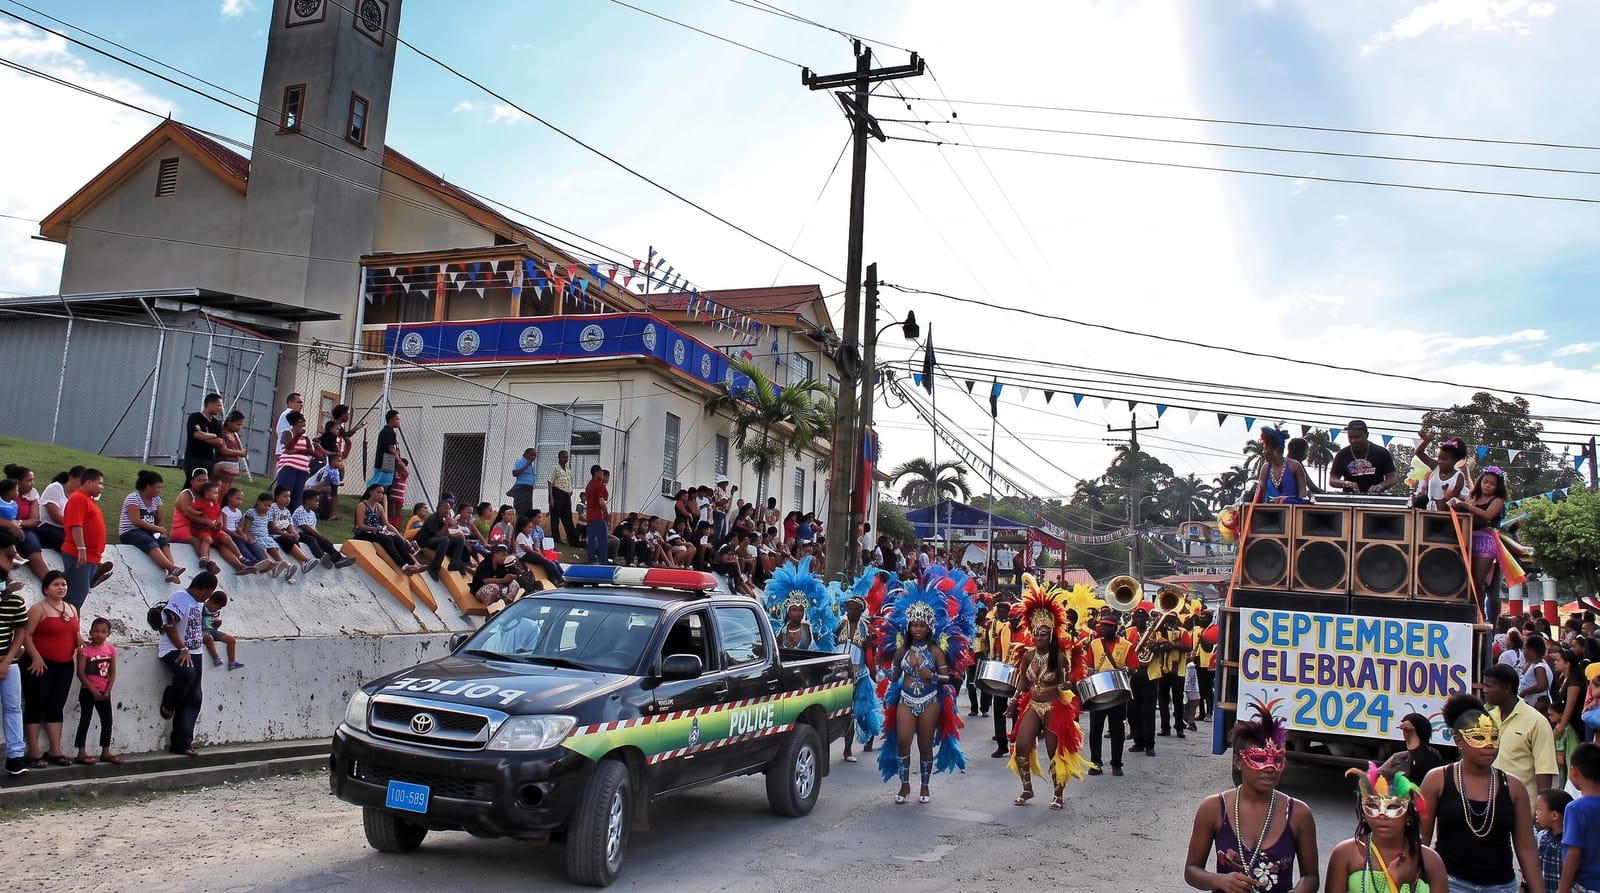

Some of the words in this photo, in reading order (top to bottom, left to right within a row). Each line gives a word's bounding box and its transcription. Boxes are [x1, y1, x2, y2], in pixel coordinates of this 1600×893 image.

[1248, 610, 1450, 660] SEPTEMBER
[1241, 648, 1468, 697] CELEBRATIONS
[728, 702, 775, 737] POLICE
[1293, 688, 1394, 733] 2024
